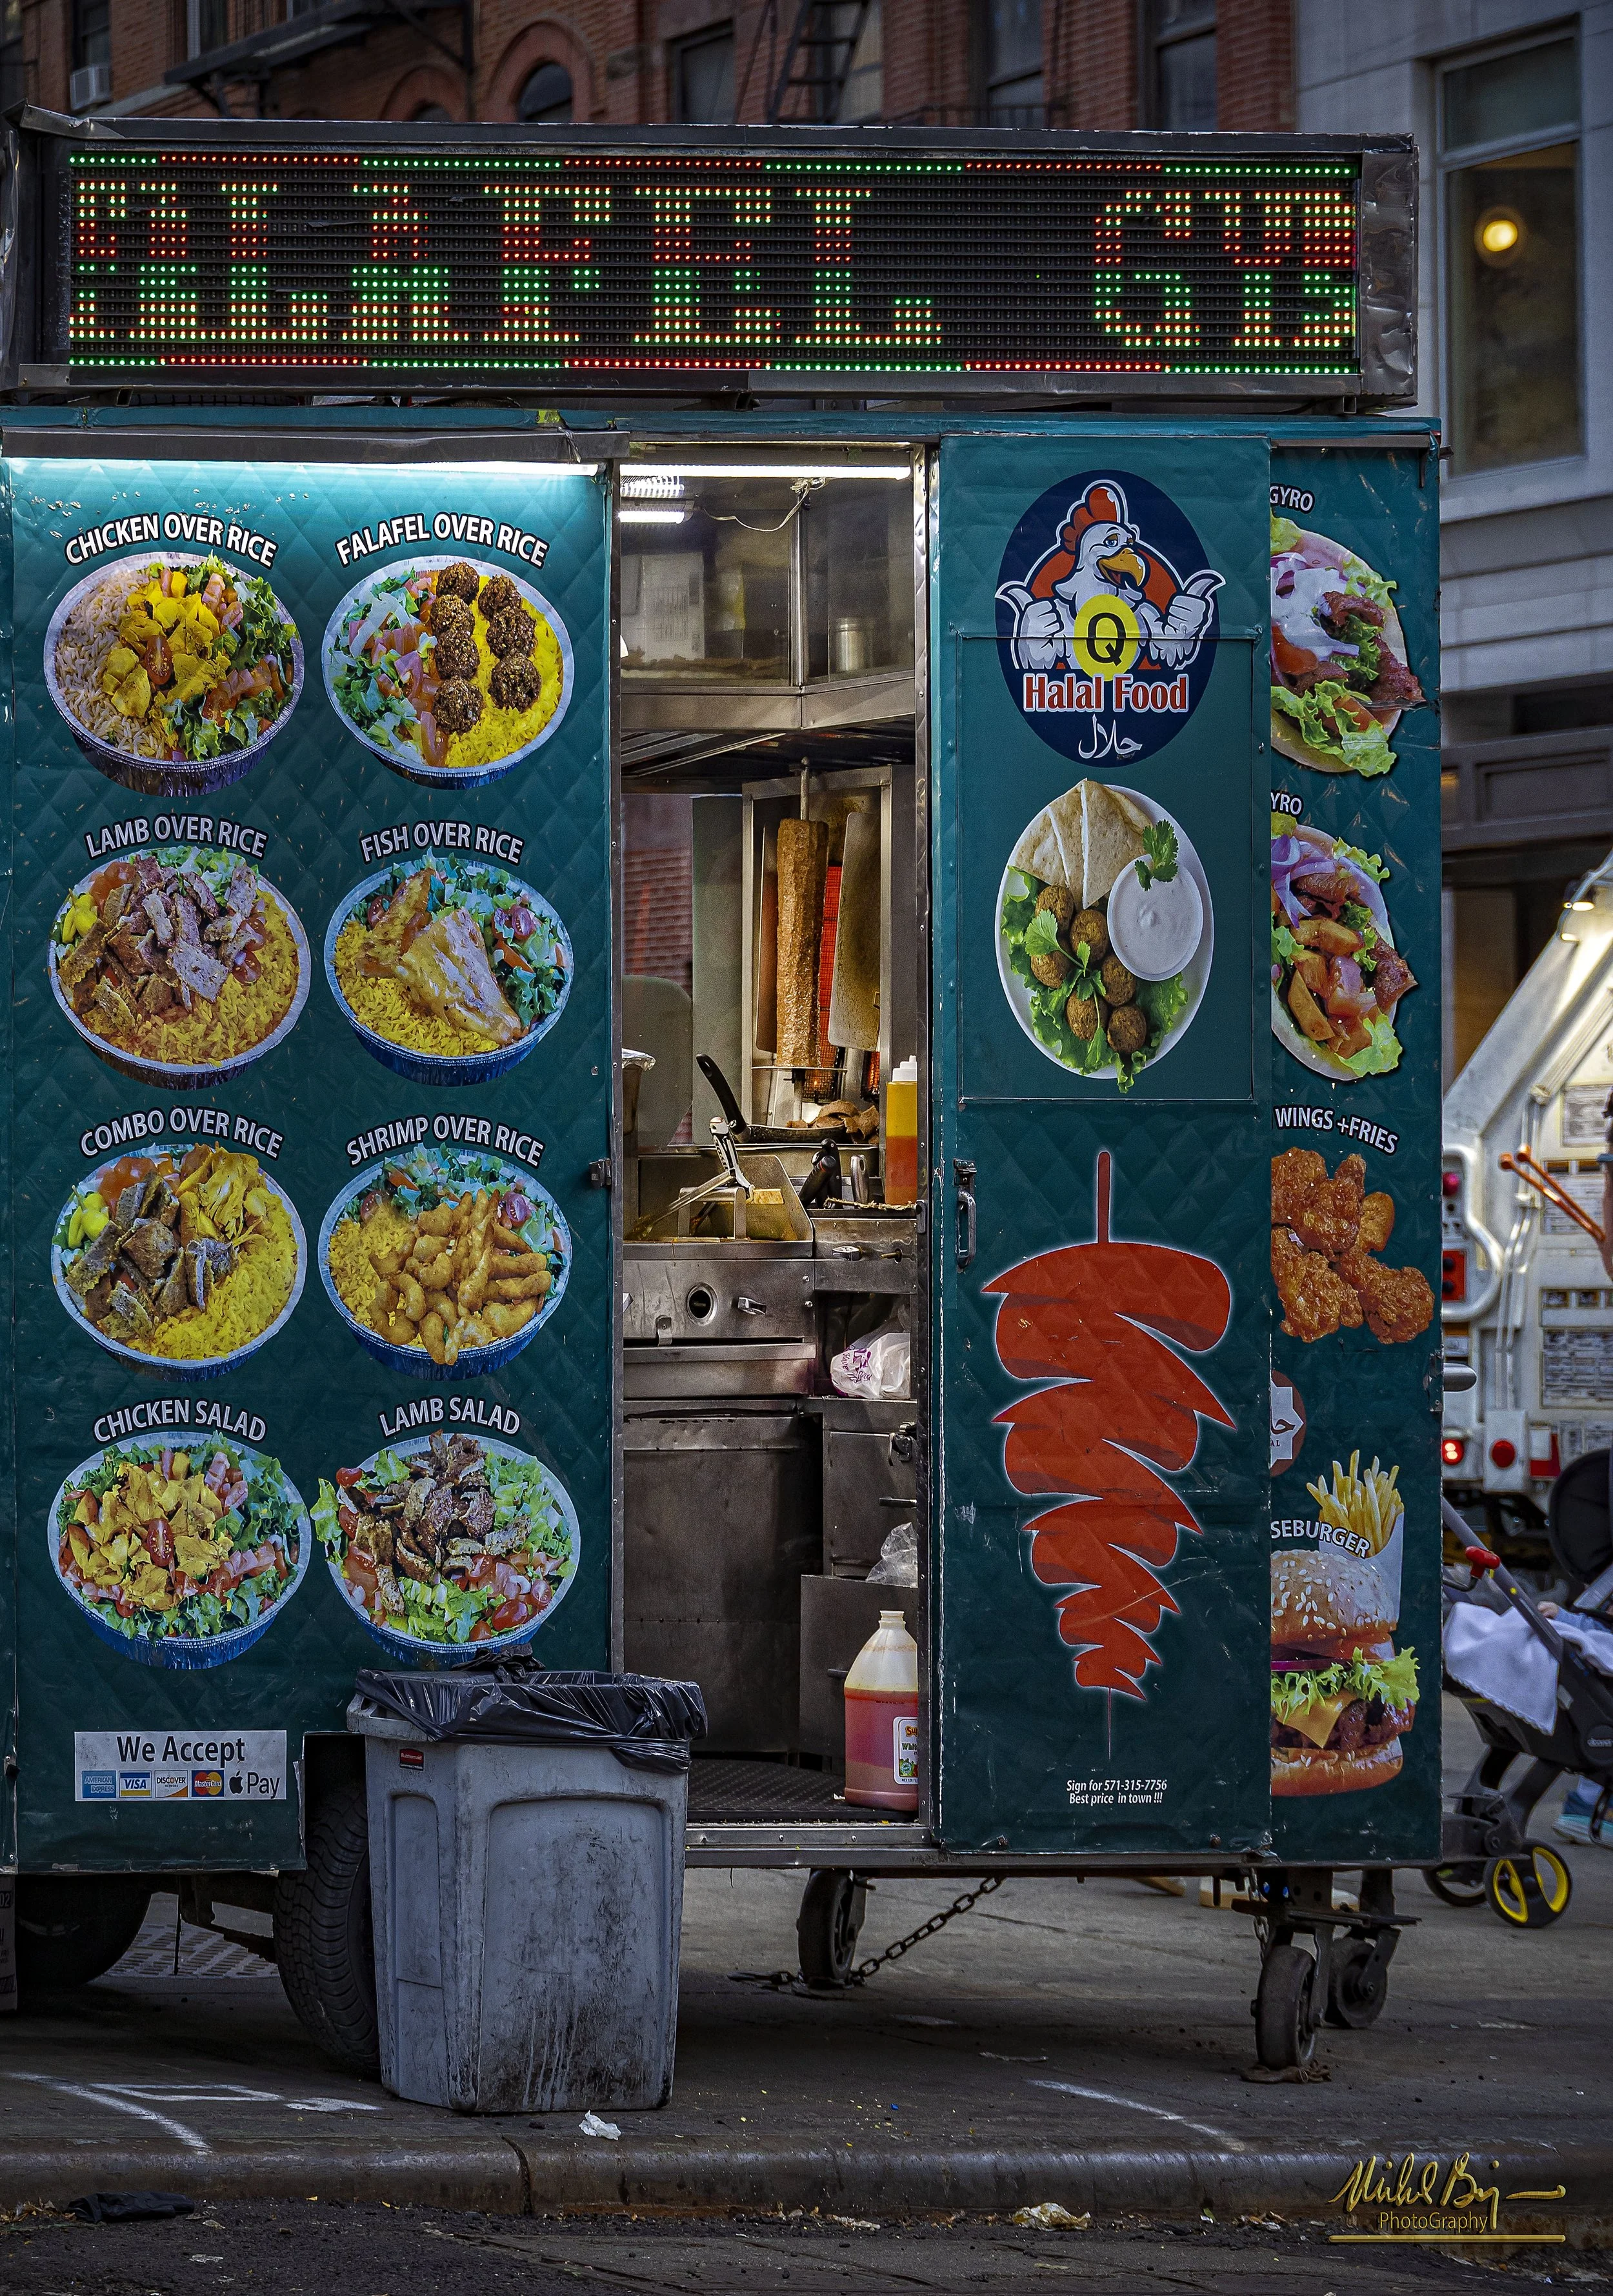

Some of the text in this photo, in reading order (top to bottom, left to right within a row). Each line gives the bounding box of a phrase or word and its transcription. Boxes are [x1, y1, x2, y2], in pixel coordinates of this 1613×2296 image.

[1270, 486, 1313, 512] GYRO
[65, 515, 276, 566] CHICKEN OVER RICE
[337, 515, 548, 566] FALAFEL OVER RICE
[1087, 612, 1127, 666] Q
[1023, 674, 1188, 712] Halal Food
[1078, 713, 1143, 759] حلال
[1270, 792, 1302, 815] YRO
[86, 816, 268, 858] LAMB OVER RICE
[362, 823, 523, 863] FISH OVER RICE
[81, 1108, 283, 1158] COMBO OVER RICE
[1275, 1108, 1333, 1130] WINGS
[350, 1115, 545, 1166] SHRIMP OVER RICE
[94, 1401, 267, 1442] CHICKEN SALAD
[381, 1398, 520, 1437] LAMB SALAD
[1271, 1520, 1369, 1557] SEBURGER
[117, 1735, 245, 1768] We Accept
[125, 1779, 146, 1789] VISA
[247, 1772, 280, 1799] Pay
[1067, 1779, 1167, 1793] Sign for 571-315-7756
[1070, 1793, 1089, 1804] Best
[1091, 1792, 1114, 1806] price
[1118, 1792, 1127, 1804] in
[1129, 1793, 1152, 1804] town
